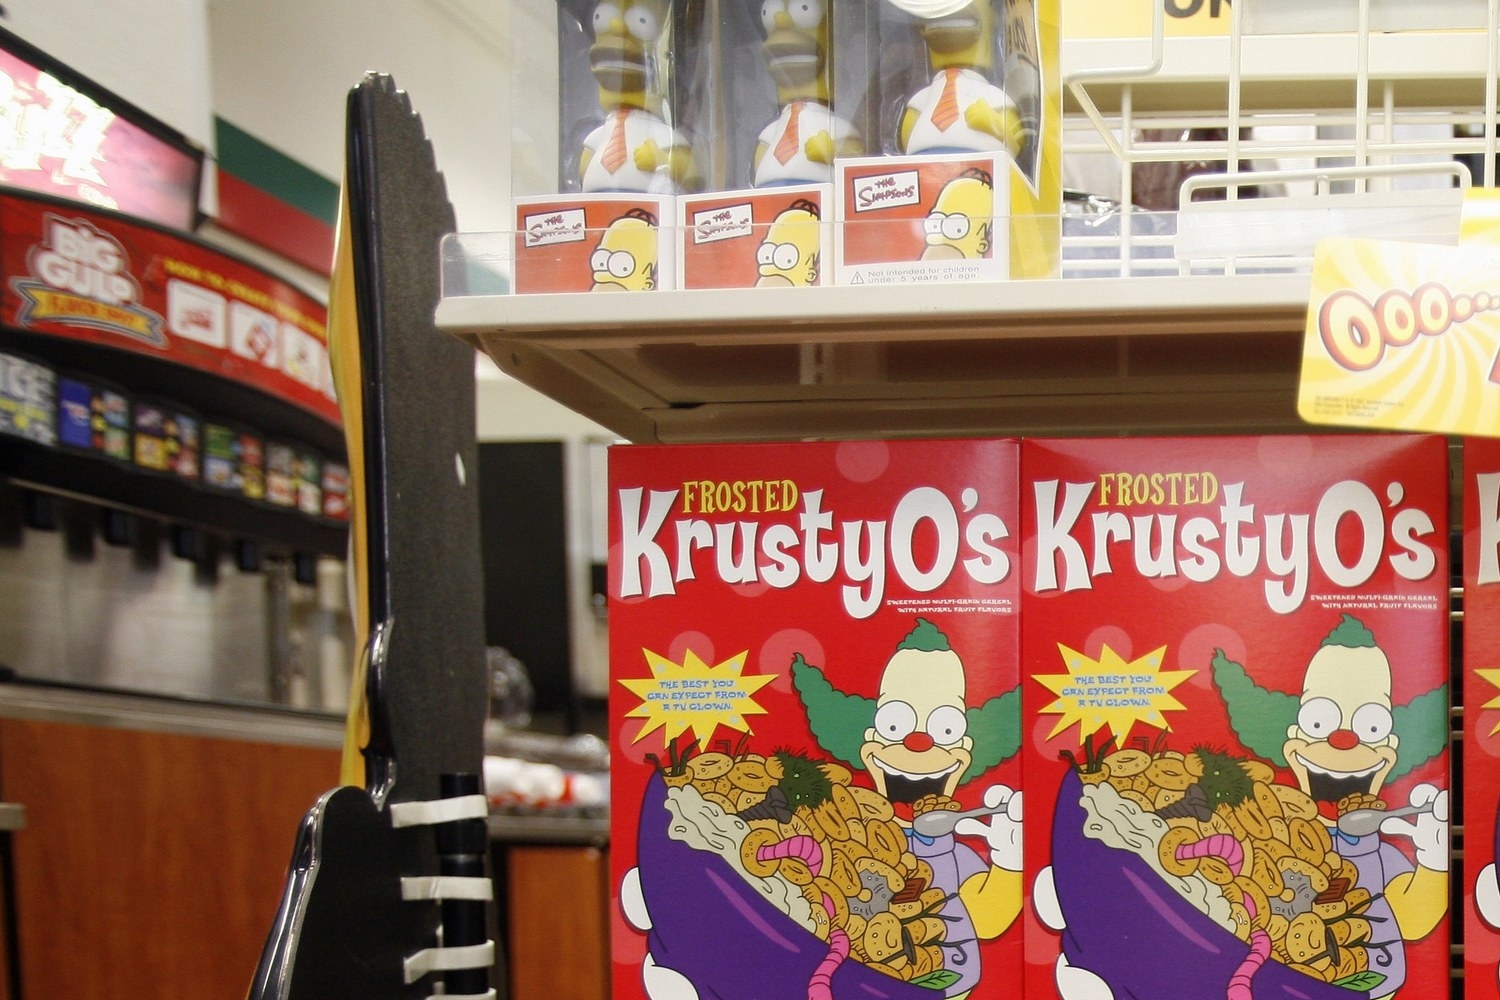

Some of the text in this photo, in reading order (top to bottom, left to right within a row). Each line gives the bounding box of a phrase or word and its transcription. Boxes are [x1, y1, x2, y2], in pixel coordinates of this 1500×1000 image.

[682, 479, 799, 514] FROSTED
[1099, 472, 1218, 506] FROSTED
[618, 485, 1011, 620] KrustyO's
[1033, 479, 1437, 614] KrustyO's
[659, 680, 734, 689] THE BEST YOU
[1074, 675, 1152, 685] THE BEST YOU
[671, 691, 712, 700] EXPECT
[715, 691, 747, 699] FROM
[1061, 687, 1165, 696] CAN EXPECT FROM
